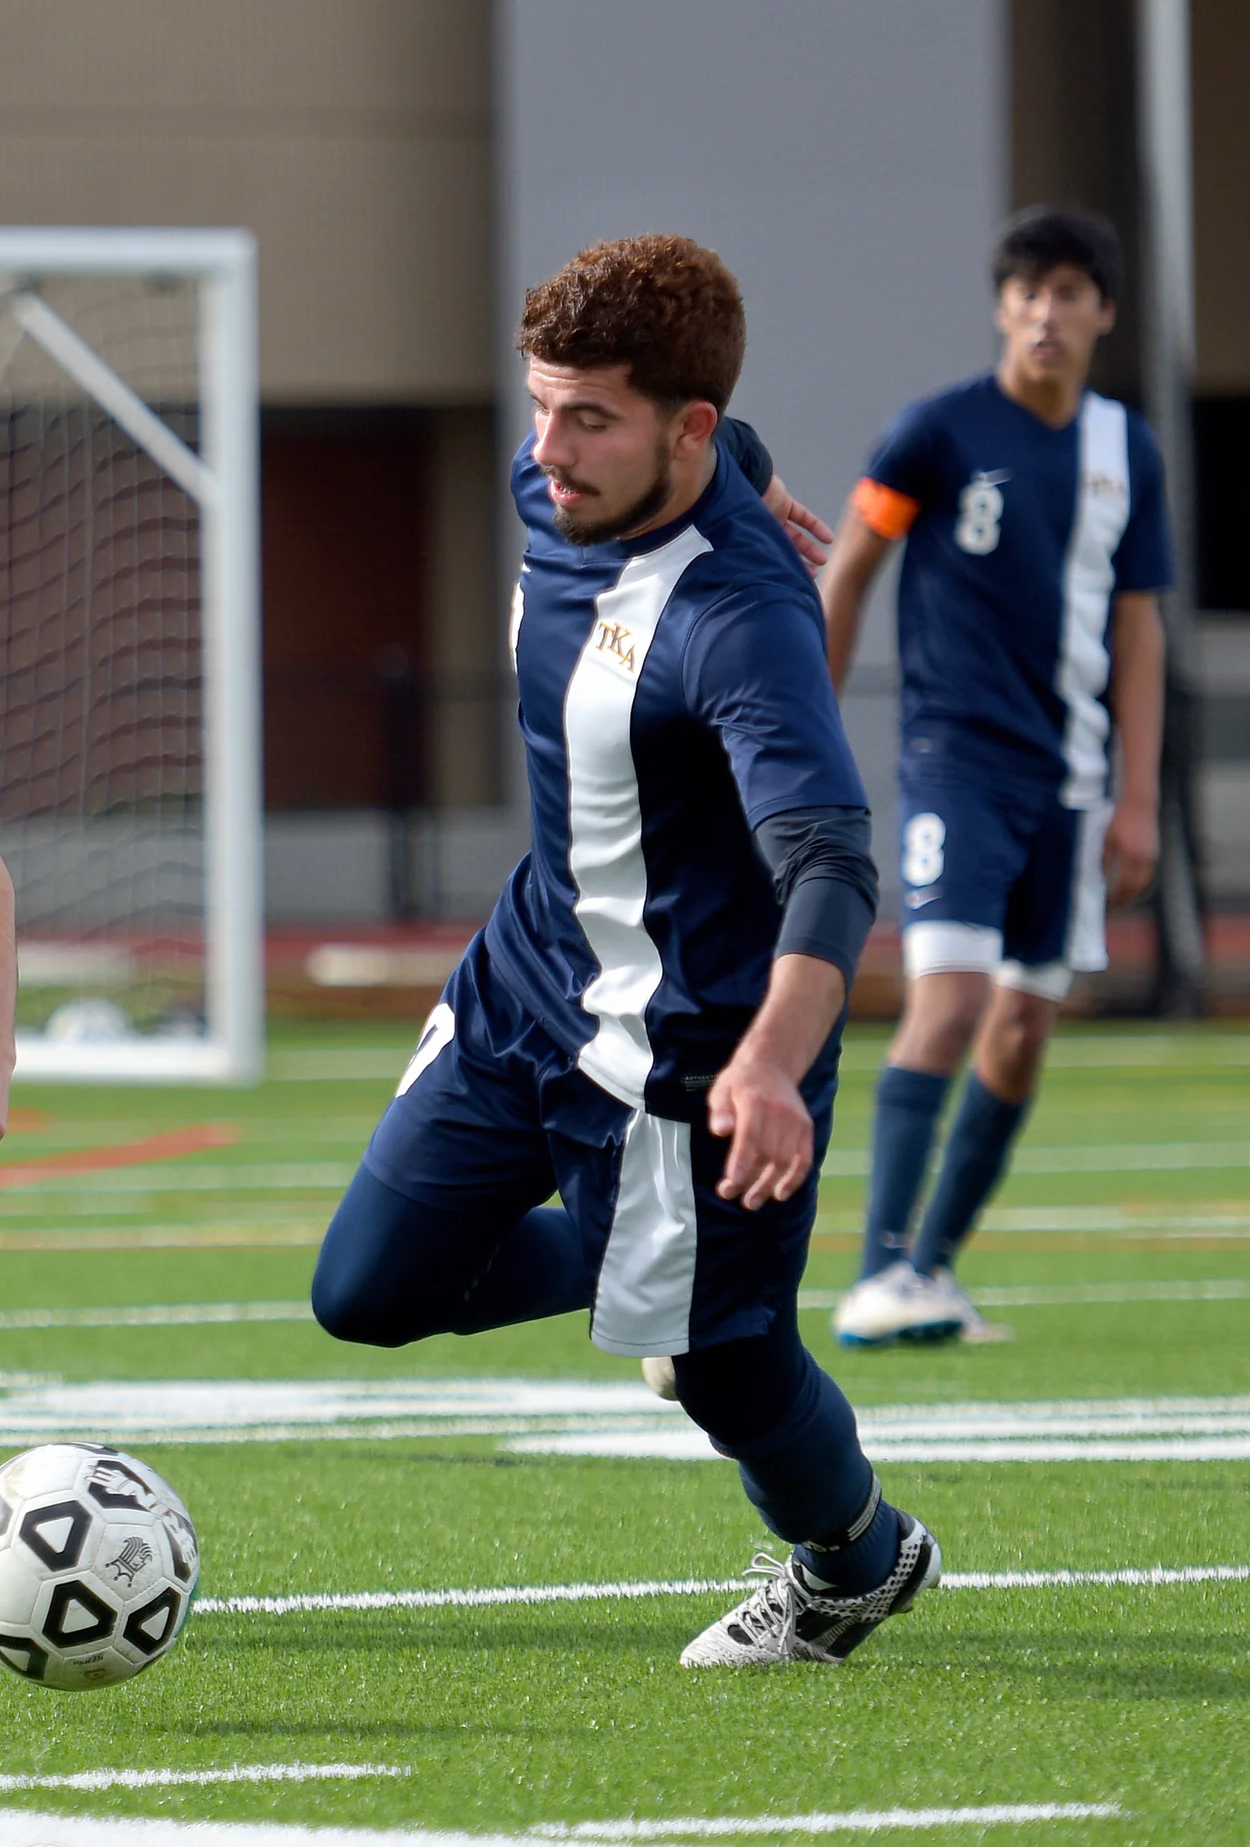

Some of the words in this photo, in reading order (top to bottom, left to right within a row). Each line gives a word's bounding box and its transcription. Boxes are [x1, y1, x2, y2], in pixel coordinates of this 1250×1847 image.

[955, 483, 1004, 555] 8
[595, 621, 636, 673] TKA
[903, 811, 946, 887] 8
